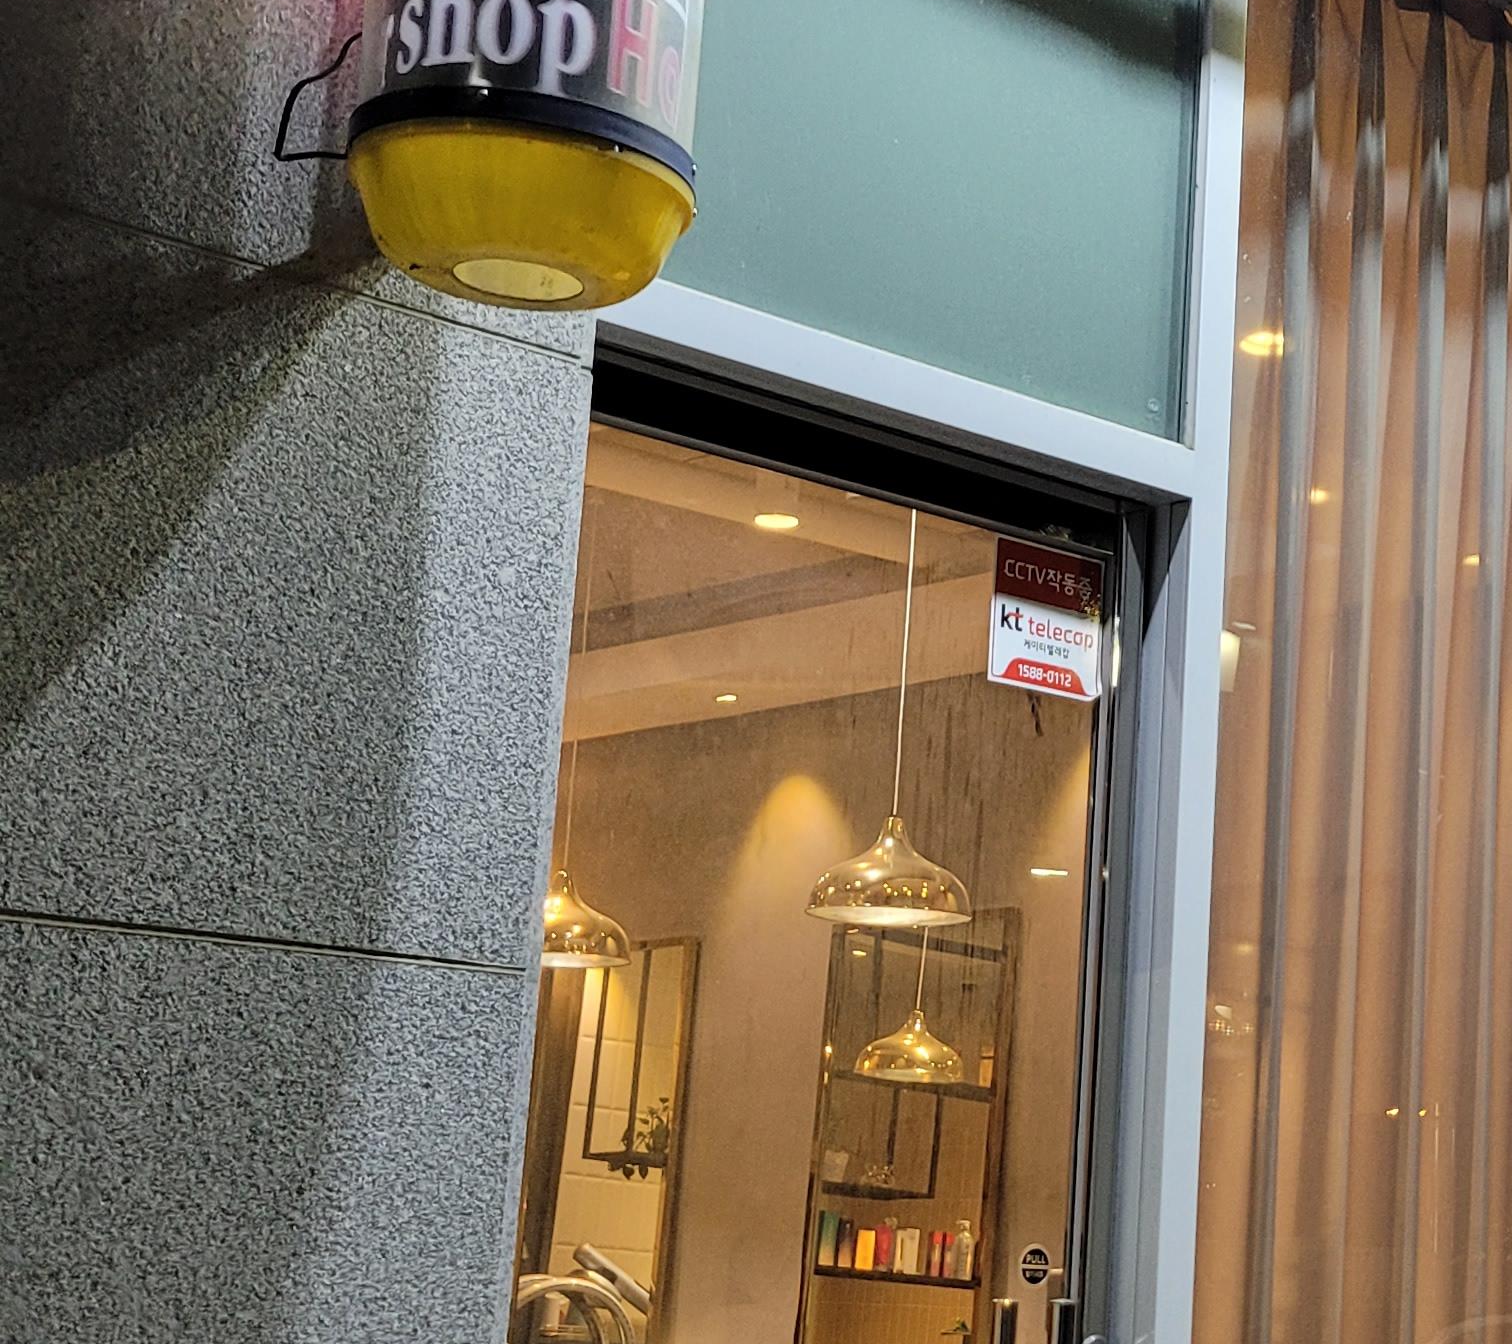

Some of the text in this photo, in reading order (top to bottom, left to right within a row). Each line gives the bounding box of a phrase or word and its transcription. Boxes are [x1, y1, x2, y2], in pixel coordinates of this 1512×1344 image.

[1000, 603, 1024, 632] kt
[1017, 663, 1072, 688] 1588-0112
[1025, 1253, 1046, 1264] PULL
